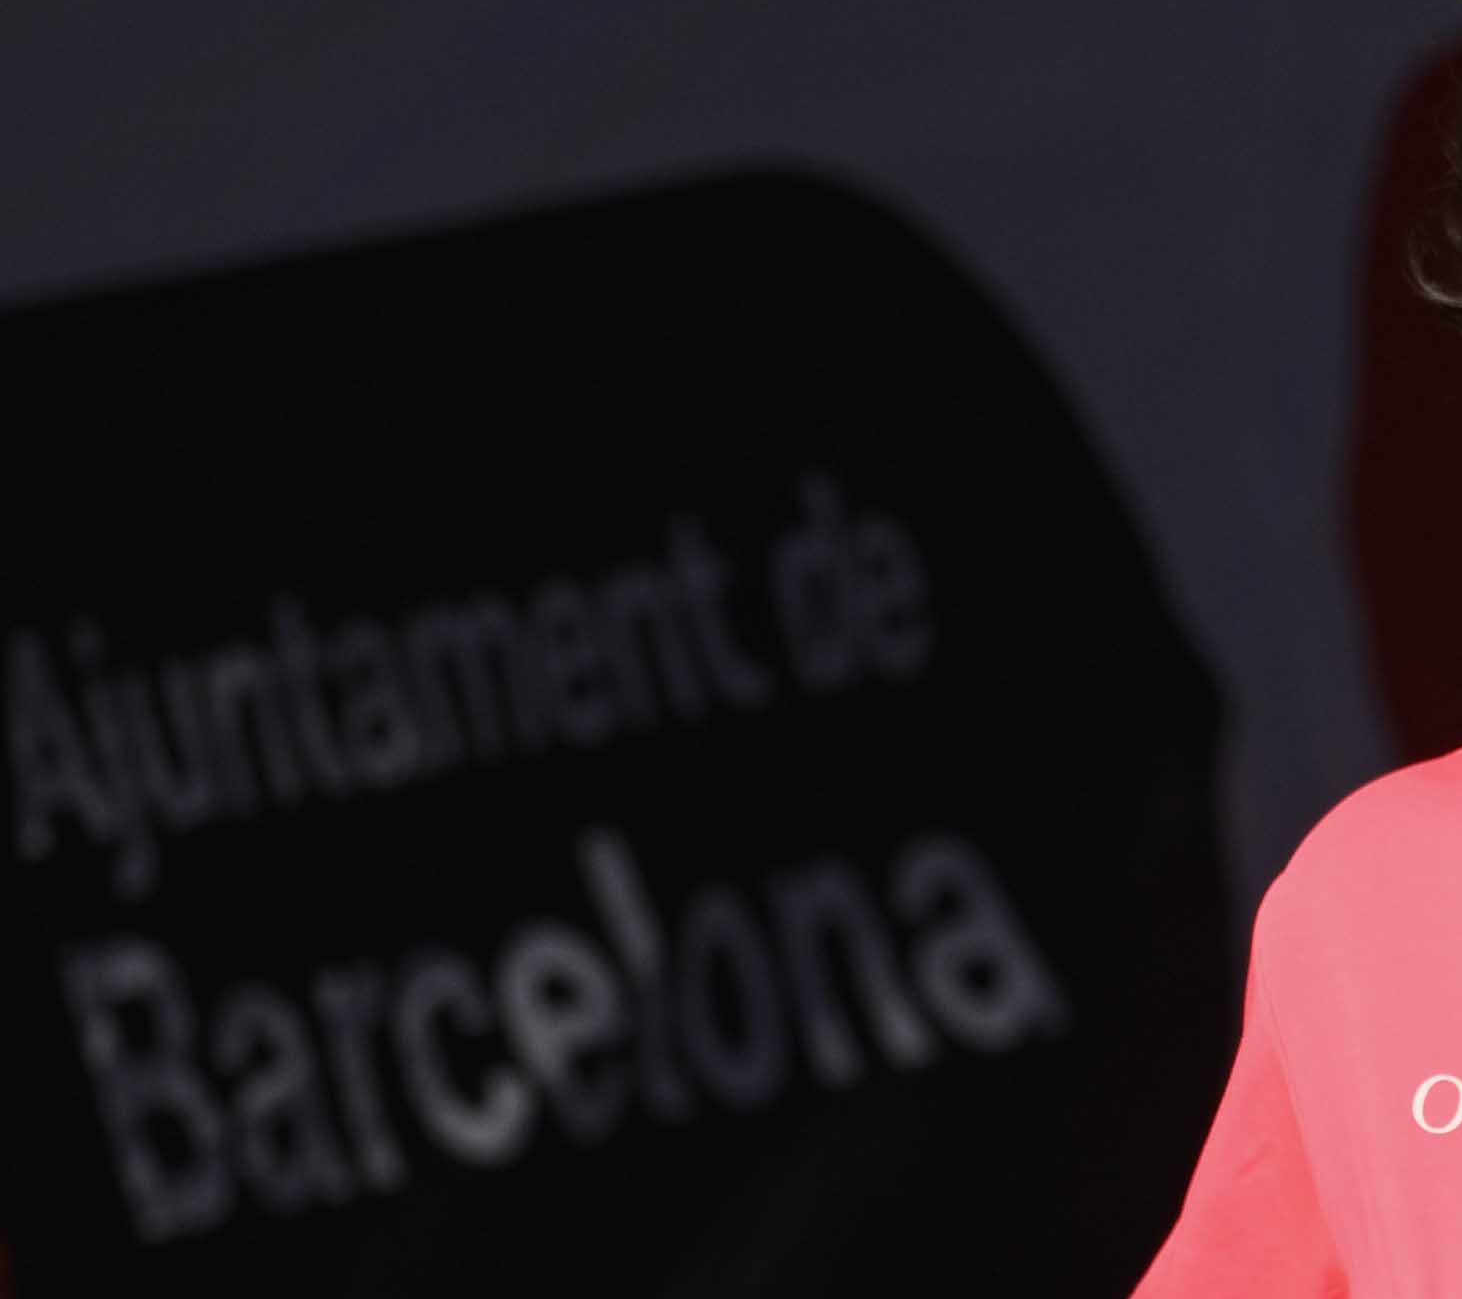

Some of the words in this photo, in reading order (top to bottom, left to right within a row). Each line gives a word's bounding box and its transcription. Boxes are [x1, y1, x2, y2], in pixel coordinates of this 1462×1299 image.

[9, 505, 776, 901] Ajuntament
[764, 464, 937, 692] de
[56, 824, 1071, 1243] Barcelona
